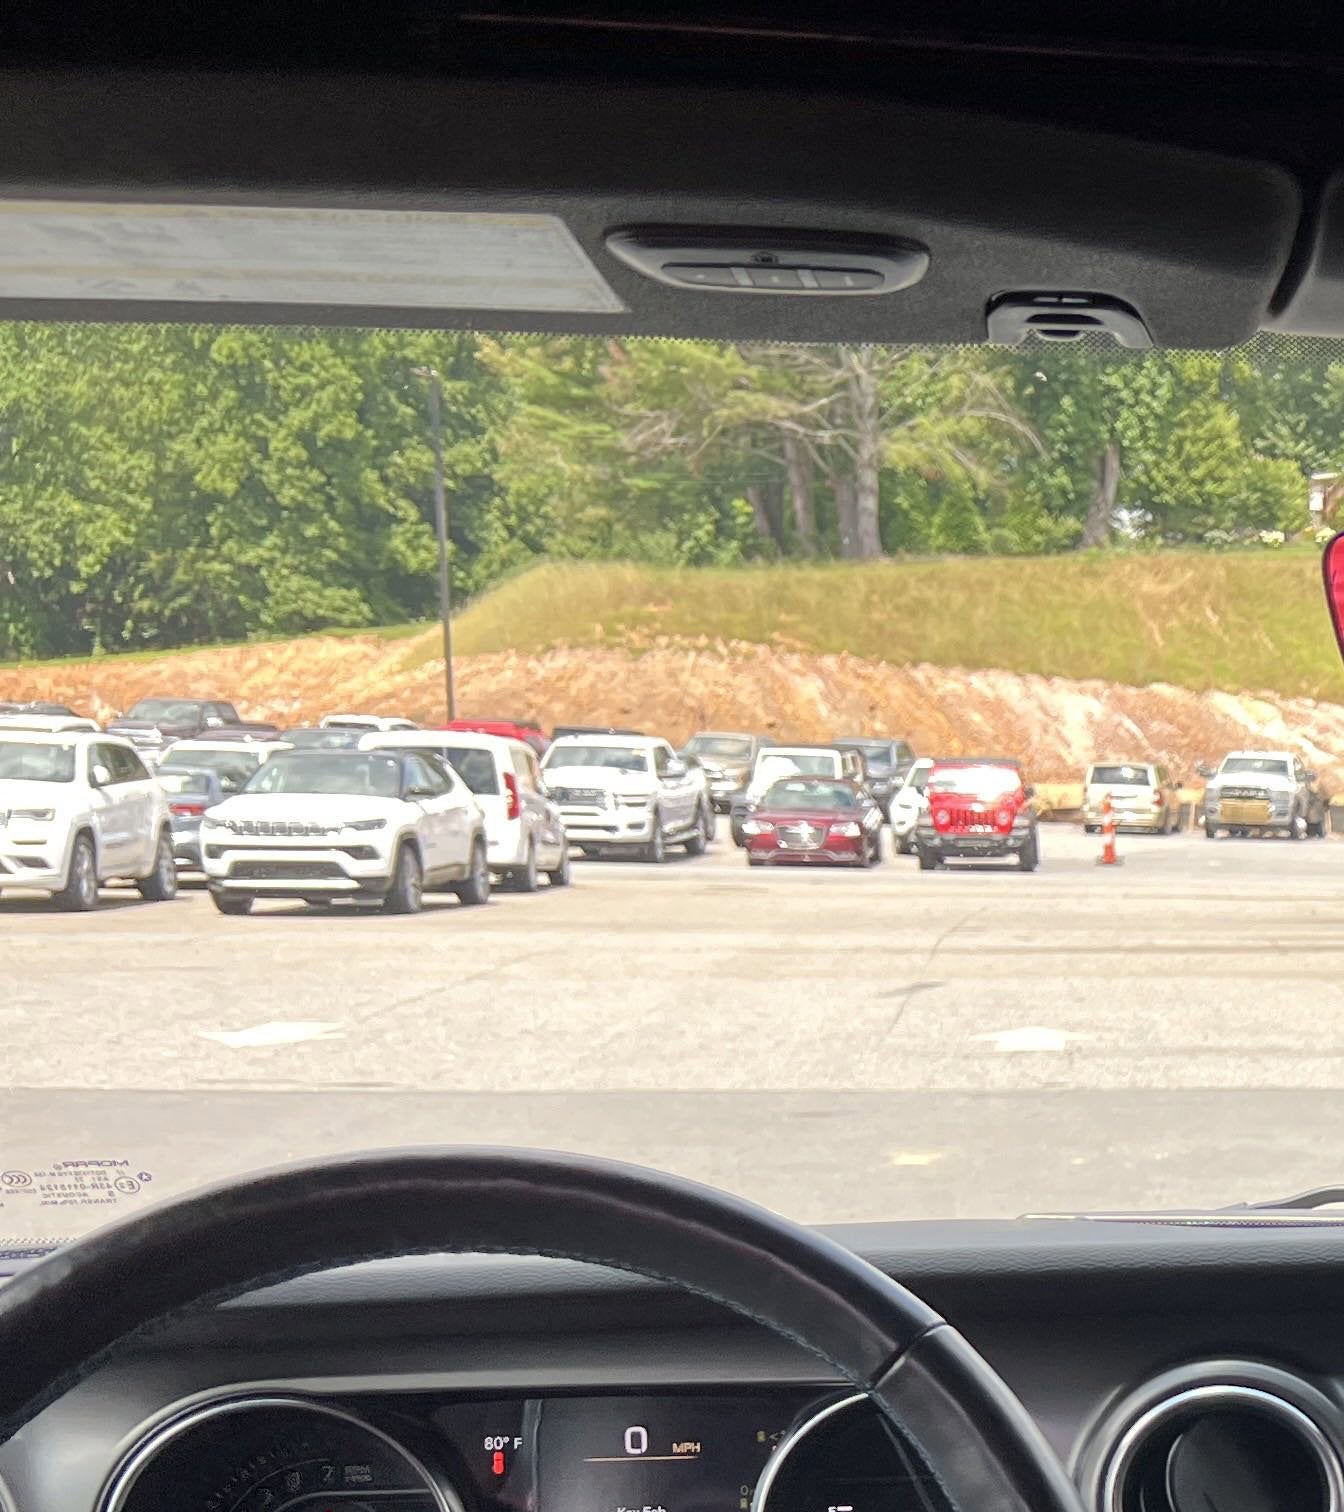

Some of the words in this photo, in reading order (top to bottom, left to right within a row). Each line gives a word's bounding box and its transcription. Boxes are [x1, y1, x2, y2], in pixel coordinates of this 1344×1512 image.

[513, 1437, 523, 1450] F
[624, 1425, 648, 1455] 0
[672, 1442, 701, 1454] MPH
